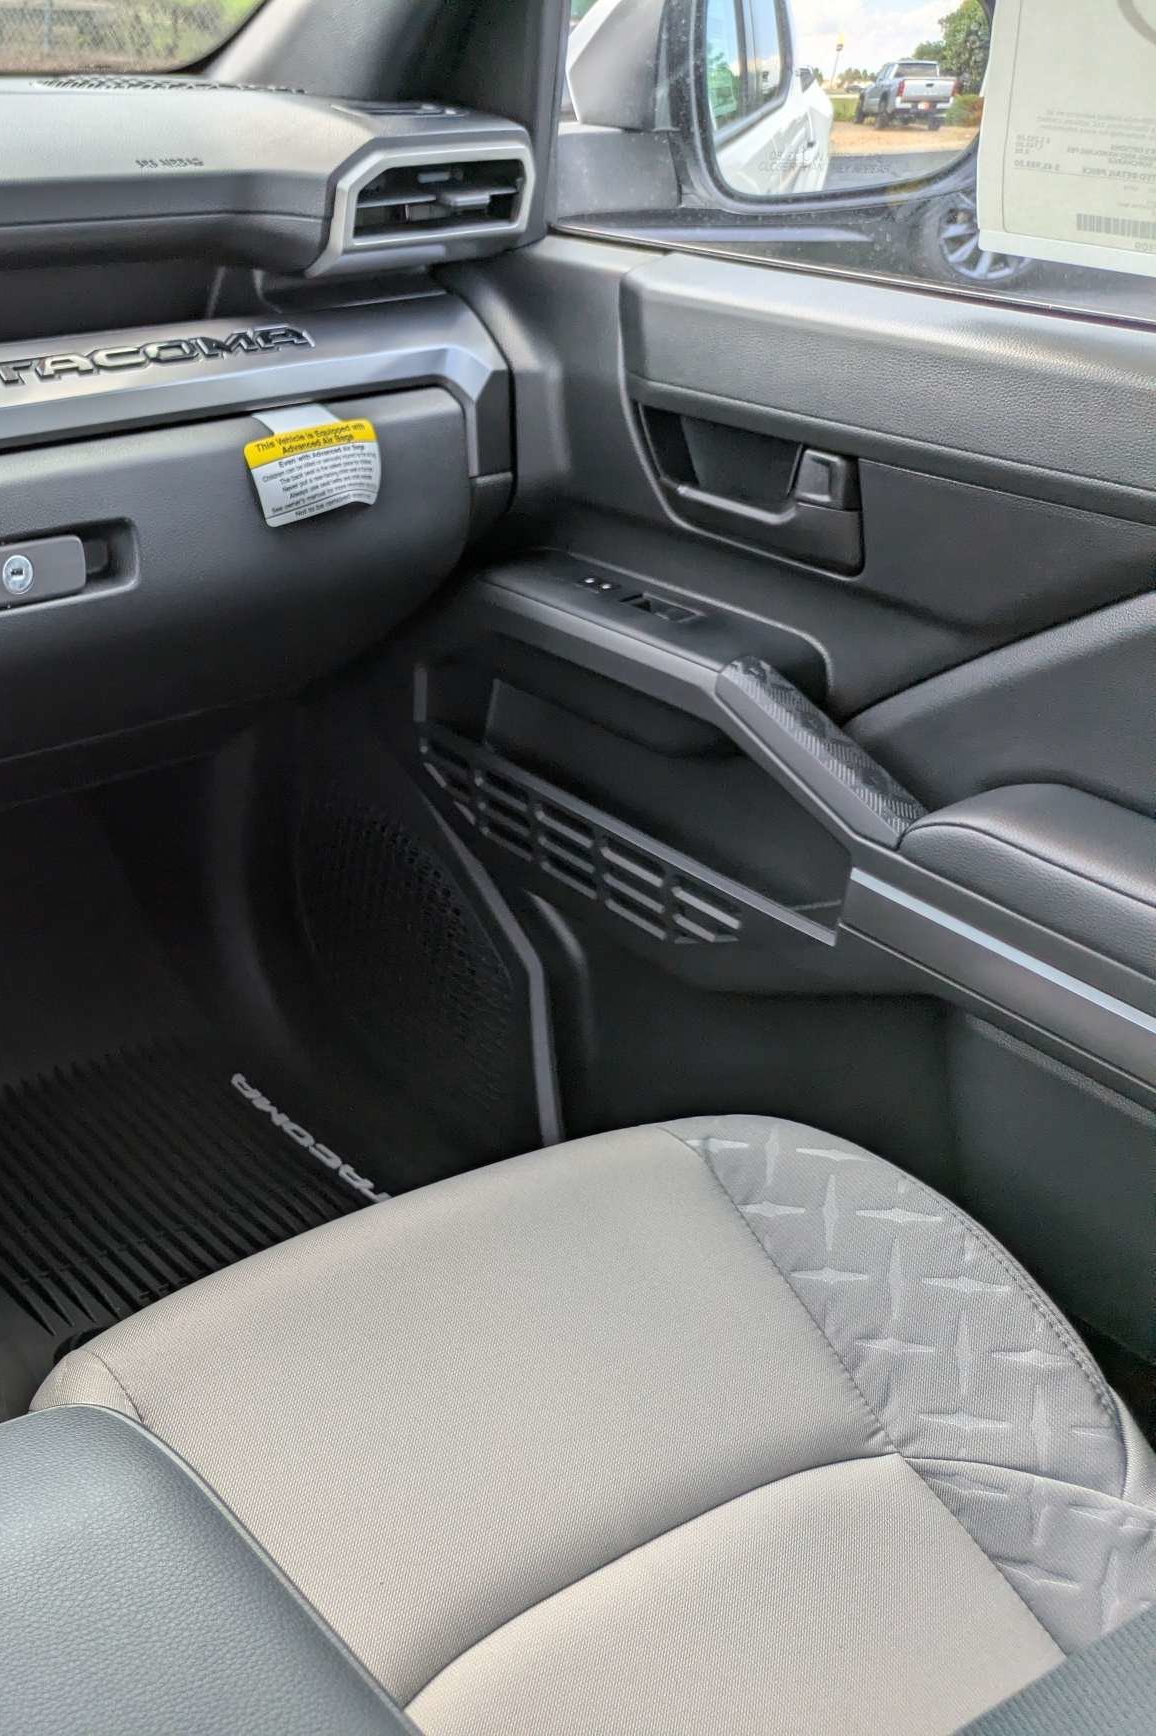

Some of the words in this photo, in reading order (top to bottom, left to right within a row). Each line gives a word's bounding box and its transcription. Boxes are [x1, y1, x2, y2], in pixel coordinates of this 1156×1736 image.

[255, 442, 275, 452] This
[278, 433, 305, 445] Vehicle
[315, 426, 351, 440] Equipped
[282, 440, 322, 454] Advanced
